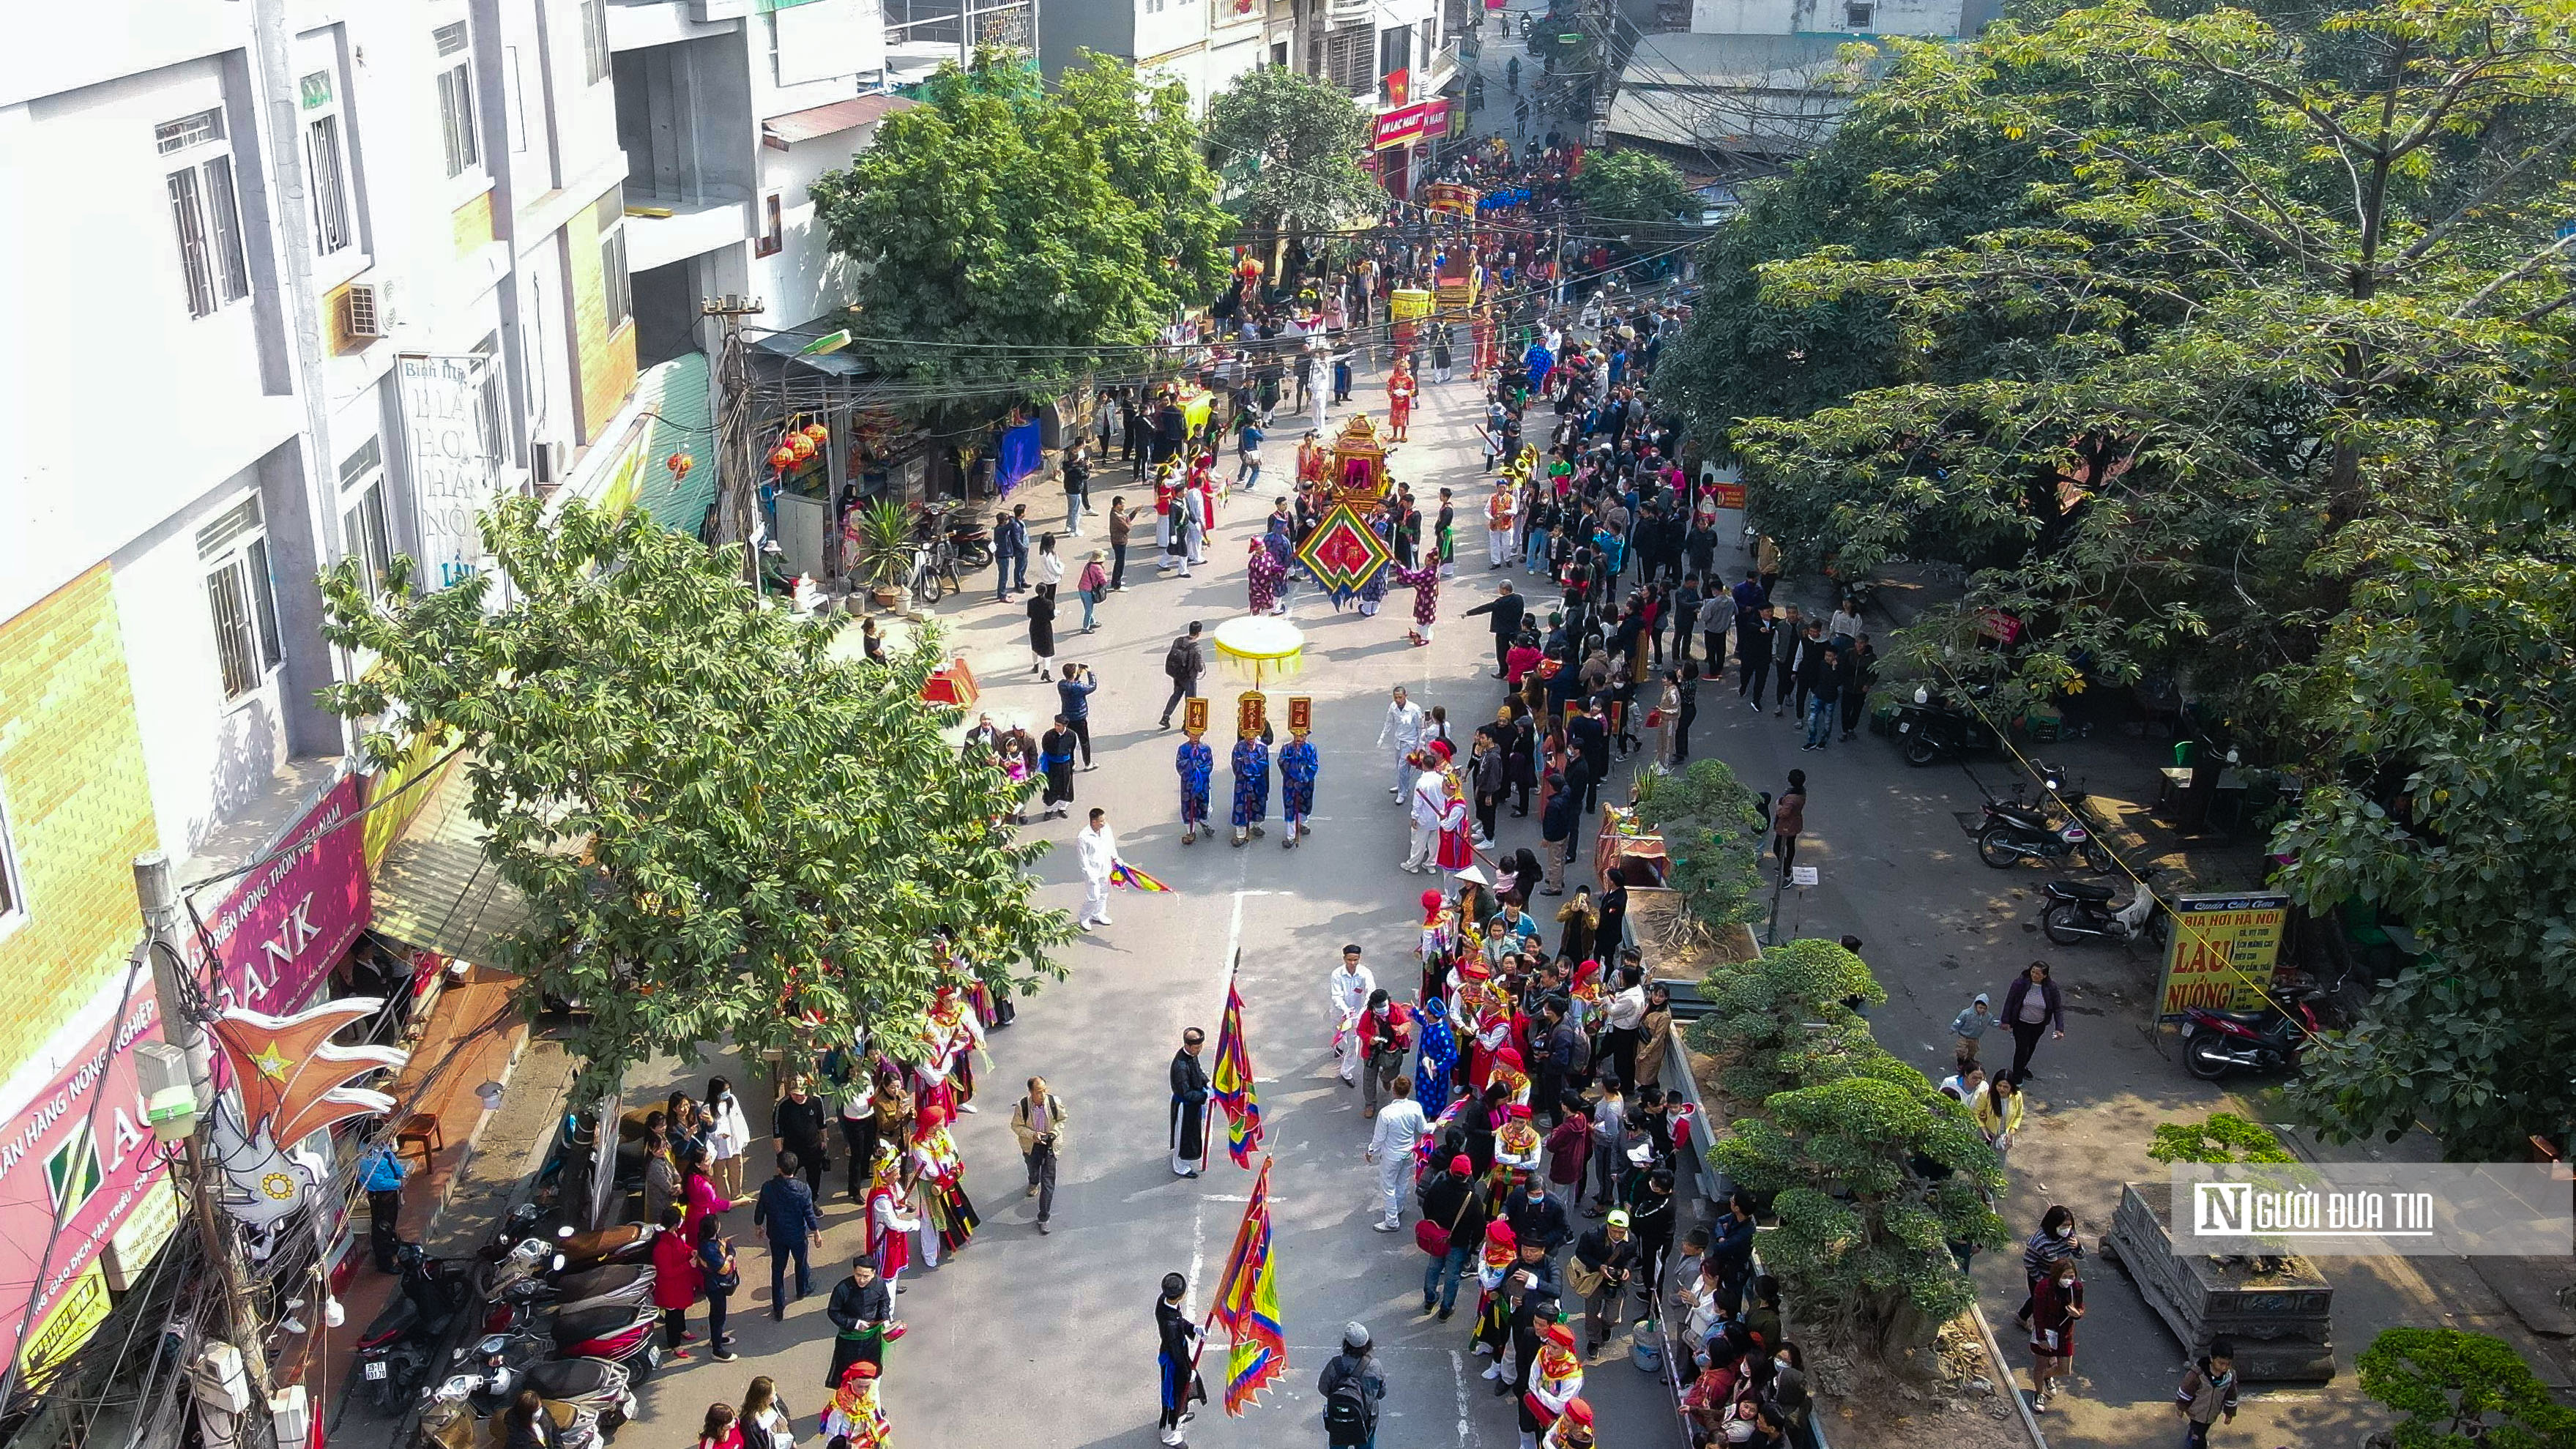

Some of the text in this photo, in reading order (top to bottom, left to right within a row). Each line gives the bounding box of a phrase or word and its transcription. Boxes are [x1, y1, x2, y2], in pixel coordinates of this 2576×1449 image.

[1402, 111, 1424, 128] MART
[239, 879, 269, 923] NÔNG
[269, 853, 297, 889] THÔN
[319, 802, 342, 832] NAM
[2184, 915, 2206, 927] BIA
[2209, 913, 2233, 926] HƠI
[2235, 911, 2252, 925] HÀ
[2172, 928, 2231, 974] LẨU
[2165, 975, 2230, 1013] NƯỚNG
[23, 1091, 67, 1149] HÀNG
[48, 1266, 70, 1296] GIAO
[70, 1237, 92, 1270] DỊCH
